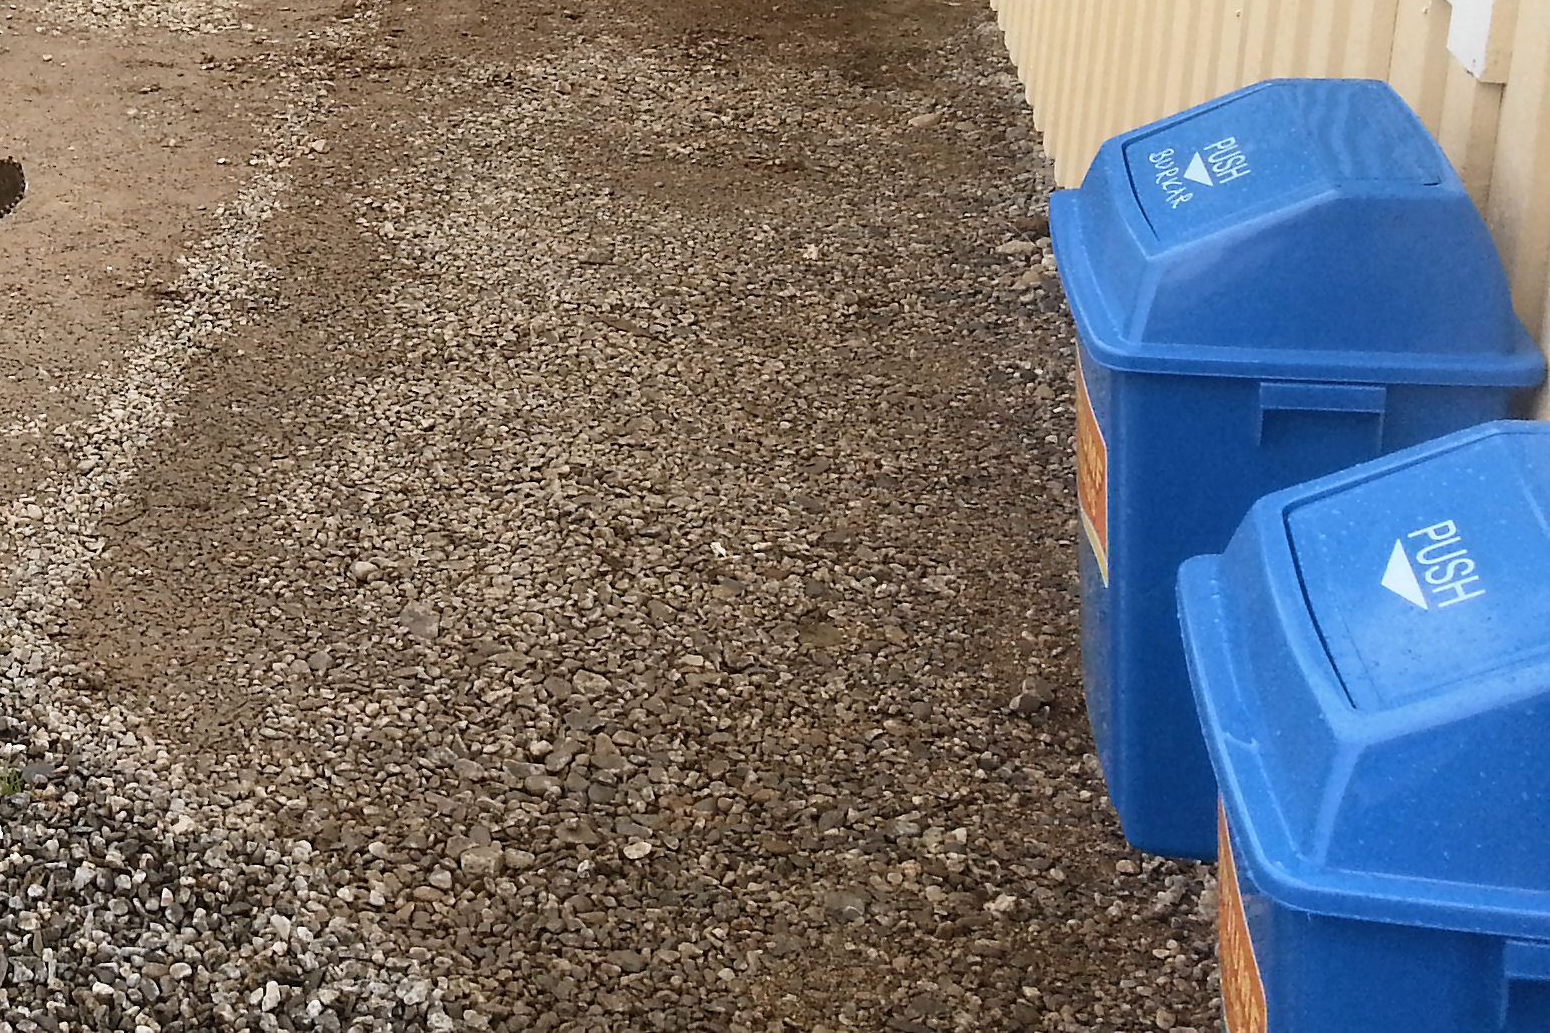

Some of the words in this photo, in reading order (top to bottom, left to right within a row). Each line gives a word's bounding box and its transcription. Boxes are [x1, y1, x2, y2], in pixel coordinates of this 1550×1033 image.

[1148, 148, 1194, 209] BURKAR
[1203, 136, 1251, 184] PUSH
[1407, 519, 1486, 608] PUSH
